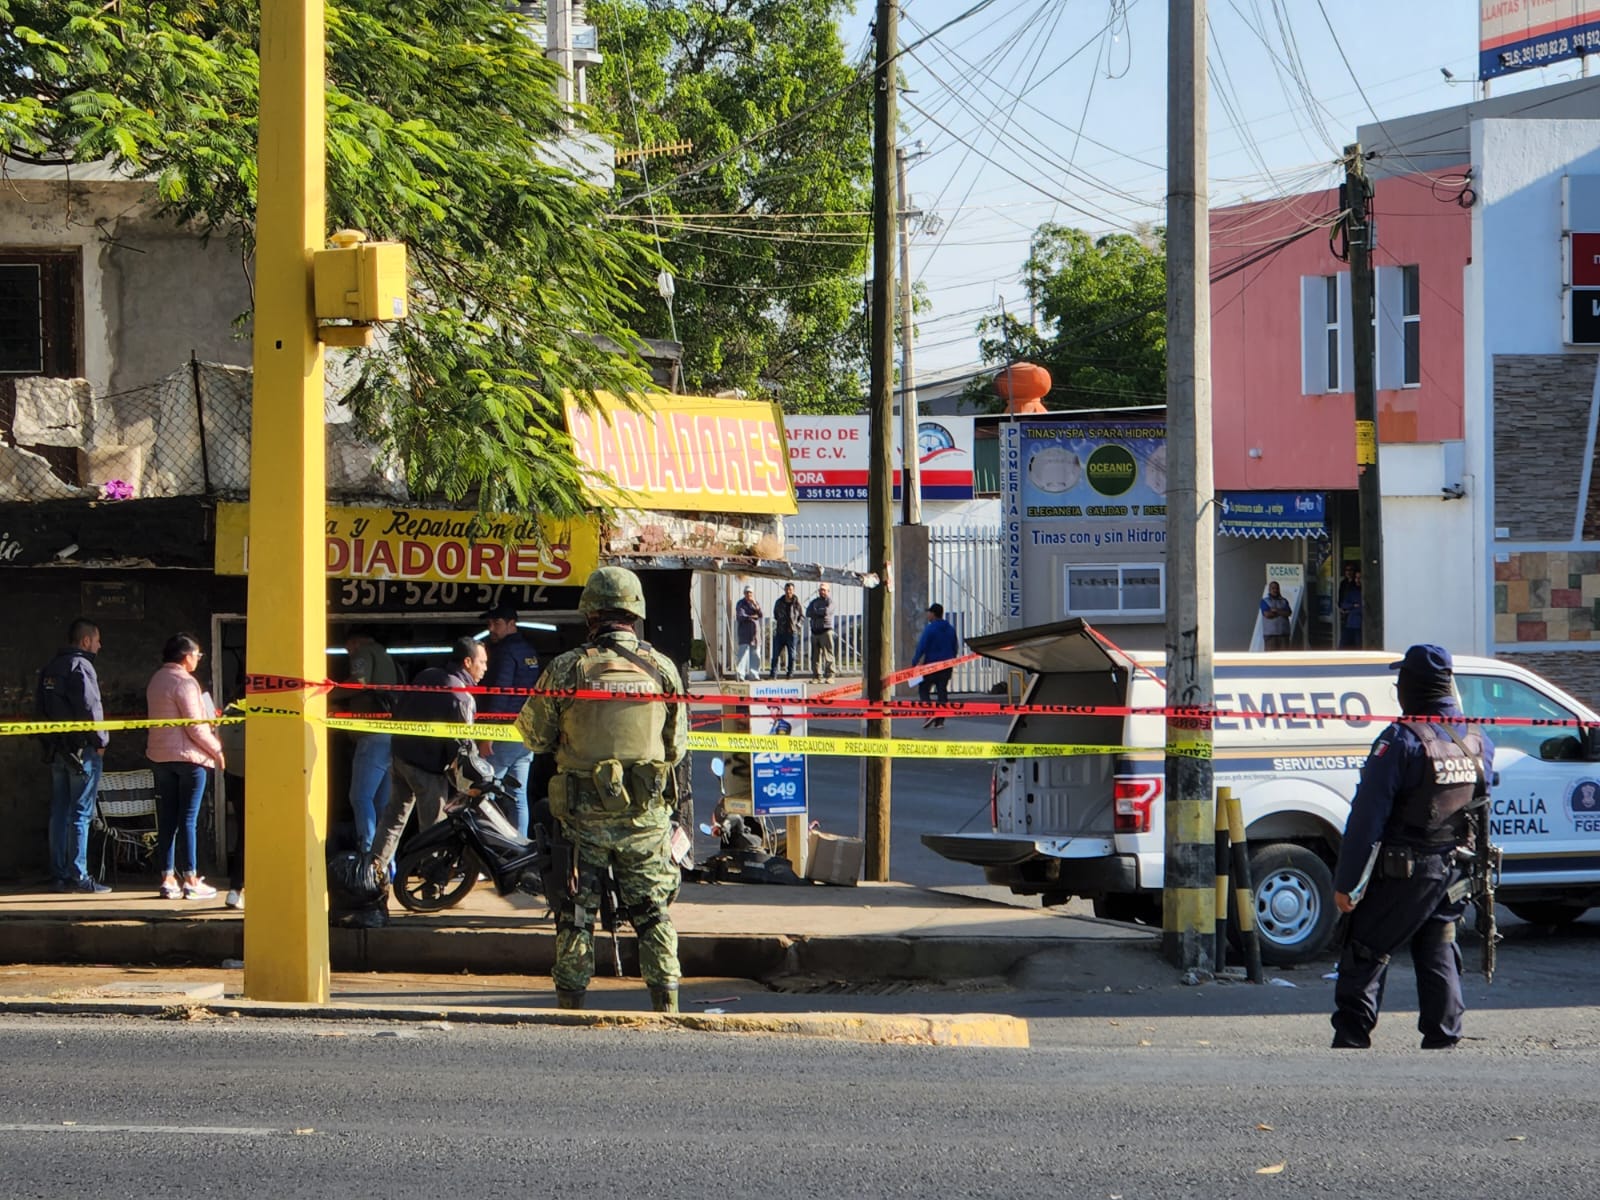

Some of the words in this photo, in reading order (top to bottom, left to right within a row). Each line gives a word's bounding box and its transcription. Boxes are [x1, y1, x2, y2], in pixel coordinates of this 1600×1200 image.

[837, 428, 859, 440] DE
[568, 406, 789, 498] RADIADORES
[790, 447, 811, 459] DE
[816, 447, 847, 459] C.V.
[1007, 428, 1019, 516] PLOMERIA
[1089, 463, 1133, 473] OCEANIC
[806, 488, 823, 498] 351
[825, 488, 841, 498] 512
[844, 488, 855, 498] 10
[857, 487, 868, 498] 56
[1027, 506, 1082, 517] ELEGANCIA
[1086, 506, 1128, 517] CALIDAD
[1131, 506, 1139, 517] Y
[349, 517, 370, 537] y
[1032, 530, 1067, 545] Tinas
[1069, 532, 1091, 544] con
[1095, 532, 1101, 546] y
[1104, 528, 1123, 543] sin
[1008, 521, 1021, 617] GONZALEZ
[1269, 566, 1300, 577] OCEANIC
[756, 686, 799, 696] infinitum
[728, 736, 779, 751] PRECAUCION
[788, 739, 835, 752] PRECAUCION
[844, 742, 889, 753] PRECAUCION
[897, 743, 939, 754] PRECAUCION
[1273, 757, 1346, 771] SERVICIOS
